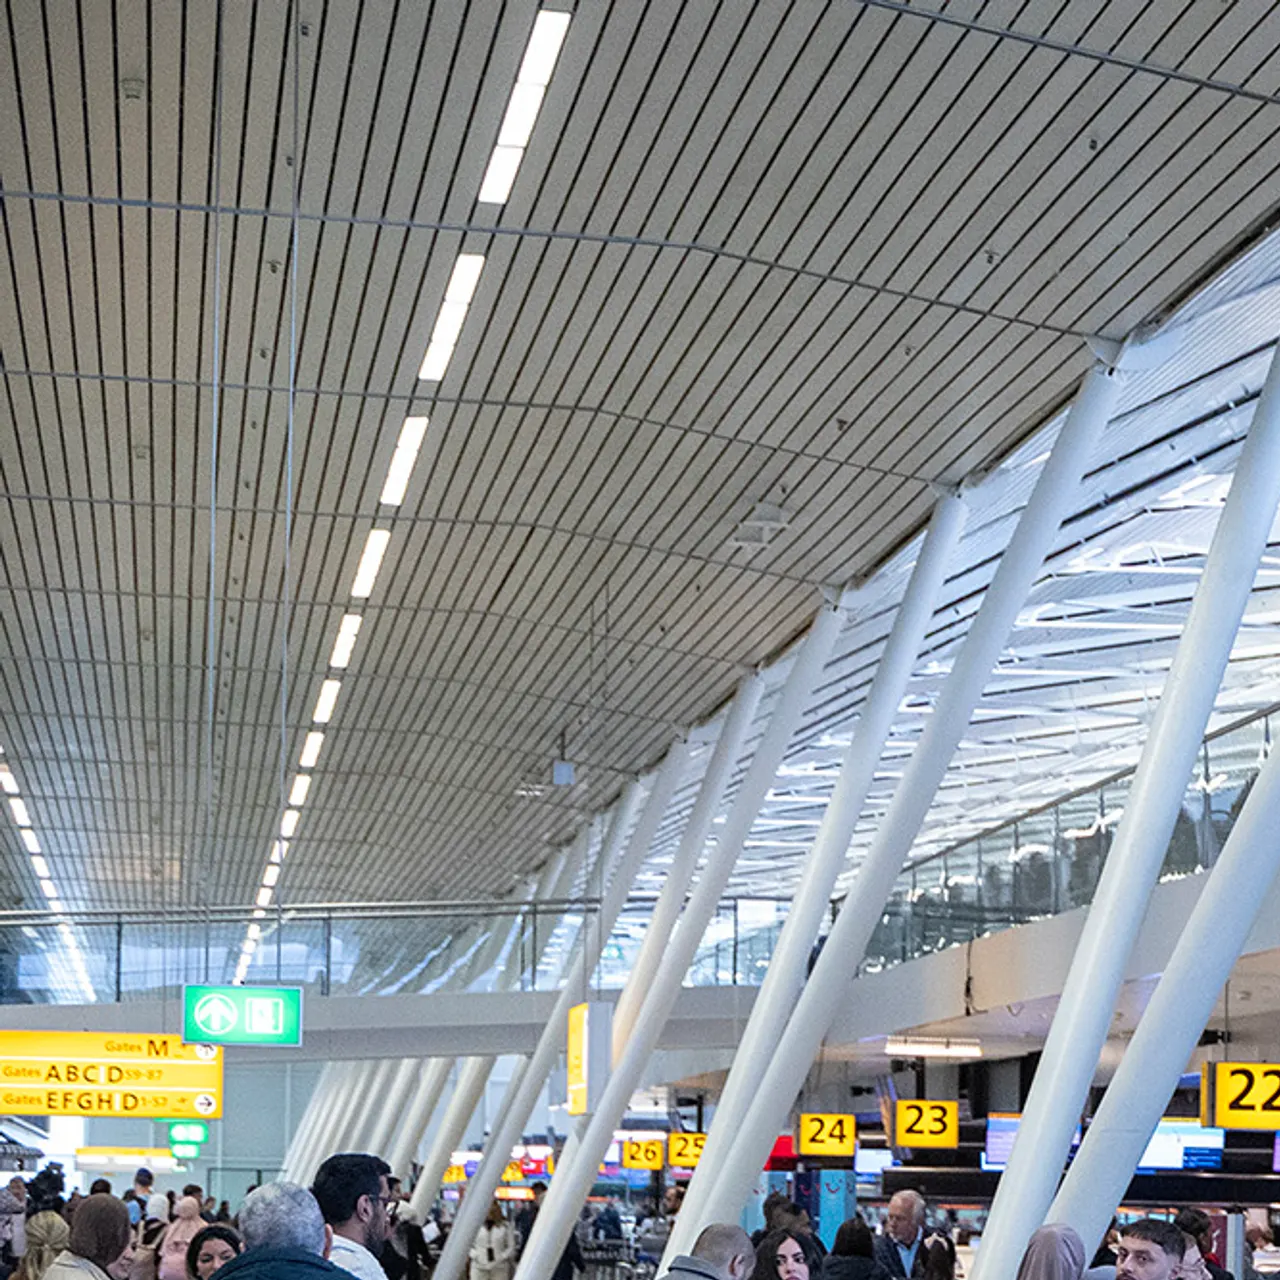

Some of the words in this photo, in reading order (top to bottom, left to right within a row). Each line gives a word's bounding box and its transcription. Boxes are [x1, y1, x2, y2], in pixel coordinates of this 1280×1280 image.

[104, 1040, 142, 1053] Gates
[147, 1040, 168, 1057] M
[905, 1105, 948, 1135] 23
[808, 1118, 847, 1144] 24
[628, 1142, 657, 1162] 26
[675, 1138, 703, 1159] 25
